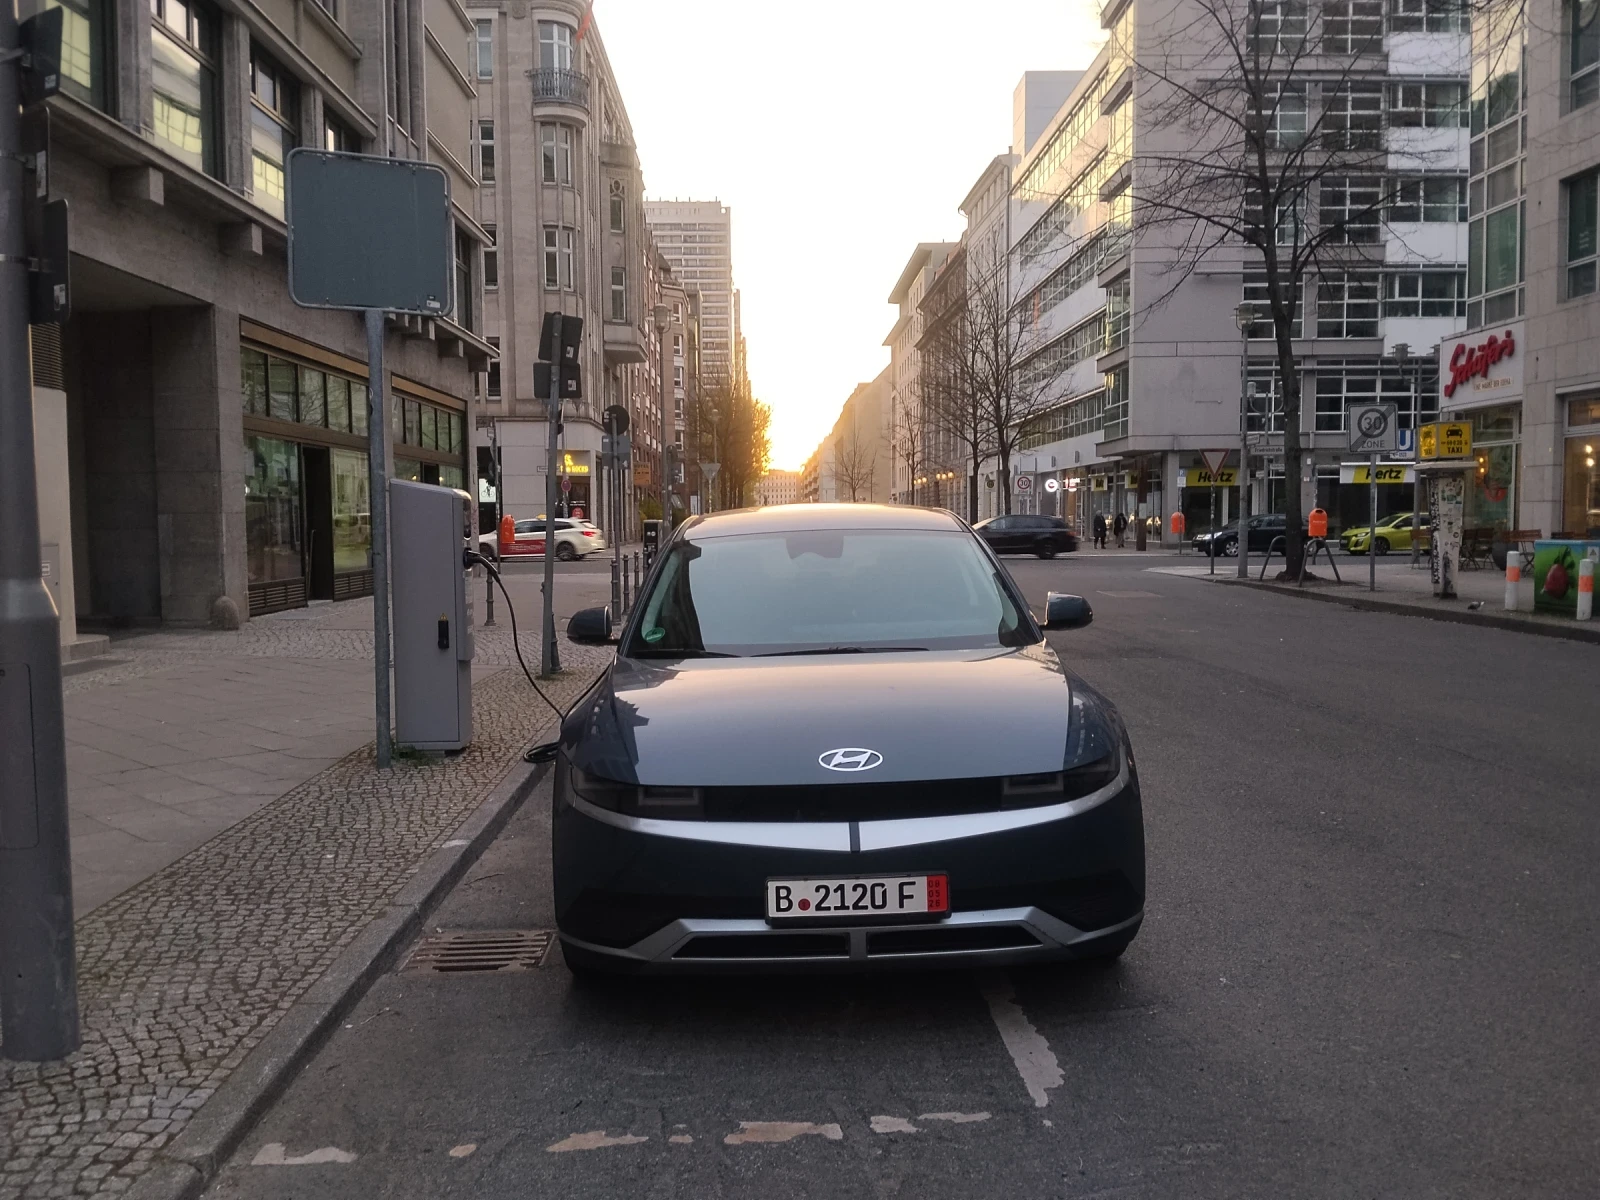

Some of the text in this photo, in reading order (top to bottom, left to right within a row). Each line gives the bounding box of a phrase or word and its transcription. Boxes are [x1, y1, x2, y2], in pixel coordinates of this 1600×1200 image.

[1444, 329, 1515, 398] Schäfer's
[1363, 416, 1384, 431] 30
[1361, 440, 1385, 449] ZONE
[1399, 430, 1411, 451] U
[1447, 446, 1463, 454] TAXI
[1019, 479, 1029, 487] 30
[1197, 471, 1234, 483] Hertz
[774, 881, 917, 913] B 2120 F
[928, 889, 941, 898] 05
